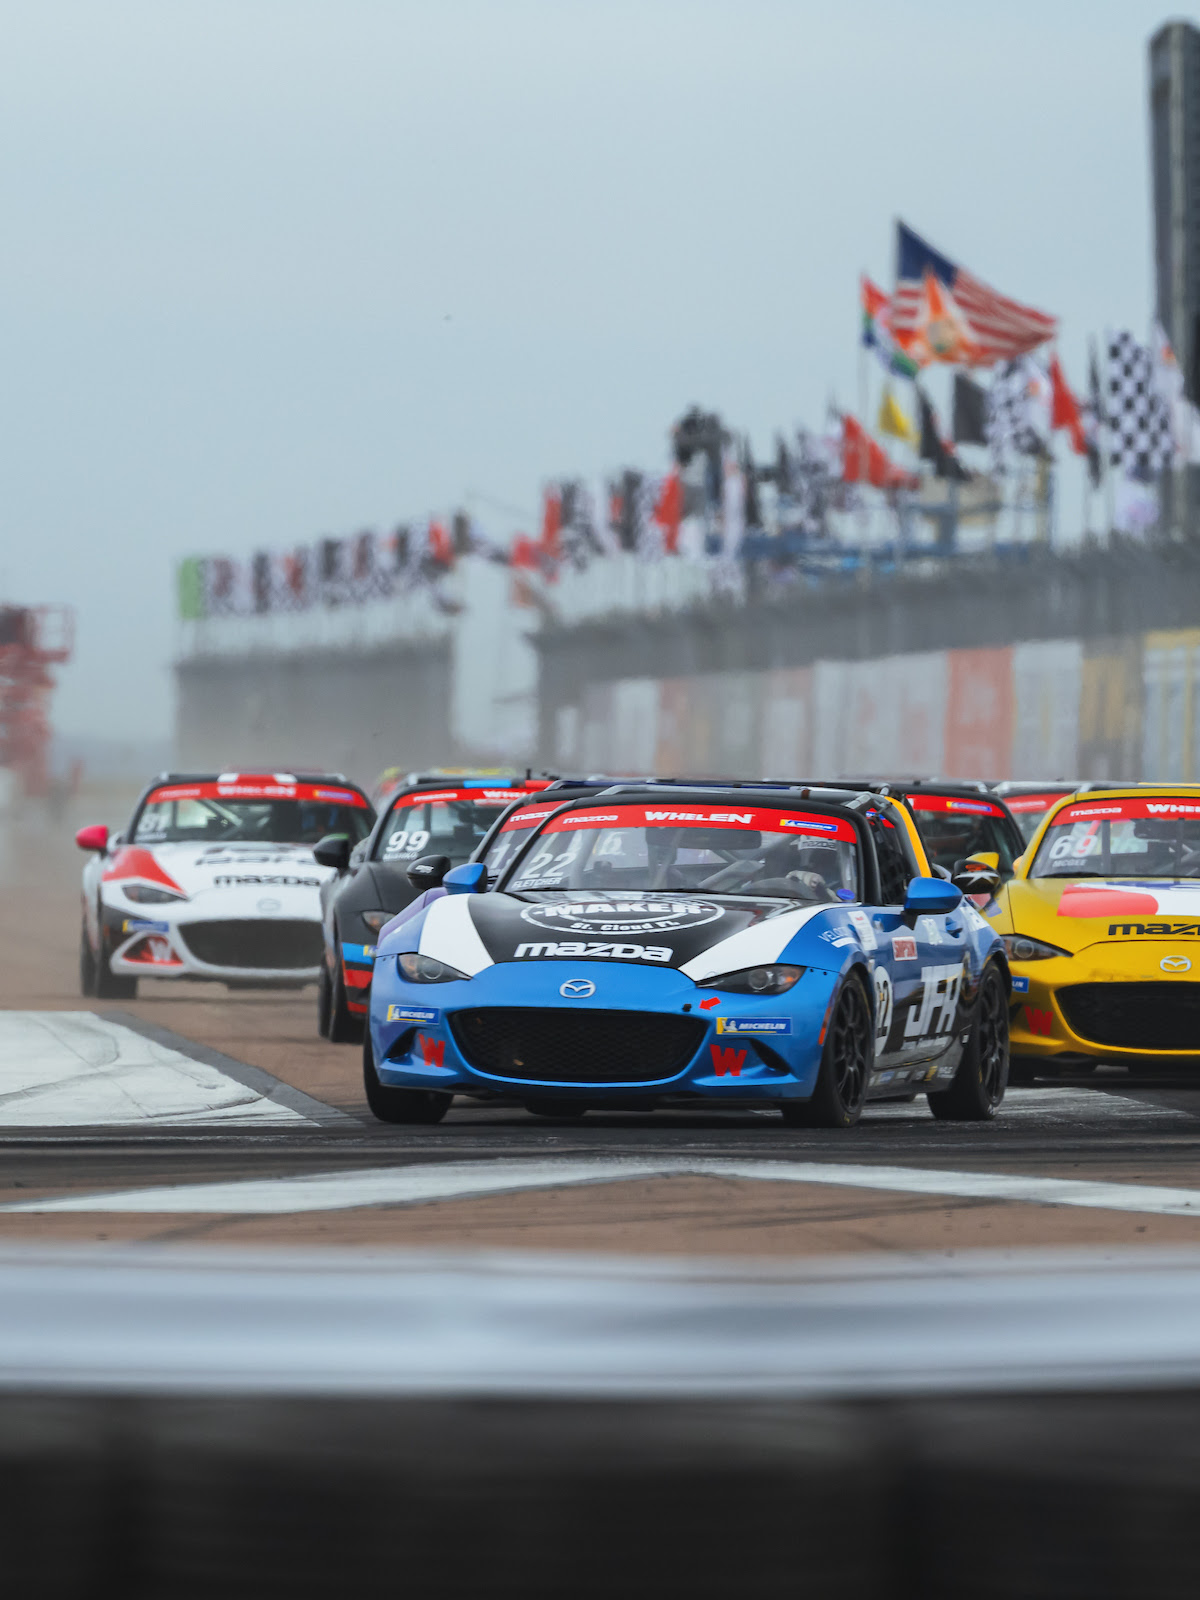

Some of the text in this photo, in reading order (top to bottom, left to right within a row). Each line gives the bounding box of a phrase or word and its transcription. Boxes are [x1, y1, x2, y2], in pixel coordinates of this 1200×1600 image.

[563, 814, 619, 825] mazda
[645, 811, 753, 824] WHELEN
[1070, 807, 1122, 817] mazda
[386, 831, 431, 853] 99
[1049, 834, 1098, 860] 69
[518, 853, 578, 881] 22
[511, 876, 563, 889] FLETCHER
[545, 902, 702, 918] MAKER
[601, 922, 652, 932] Cloud
[513, 941, 674, 962] mazda
[399, 1010, 437, 1020] MICHELIN
[1024, 1006, 1054, 1036] W
[738, 1021, 787, 1031] MICHELIN
[418, 1034, 446, 1068] W
[709, 1044, 747, 1077] W
